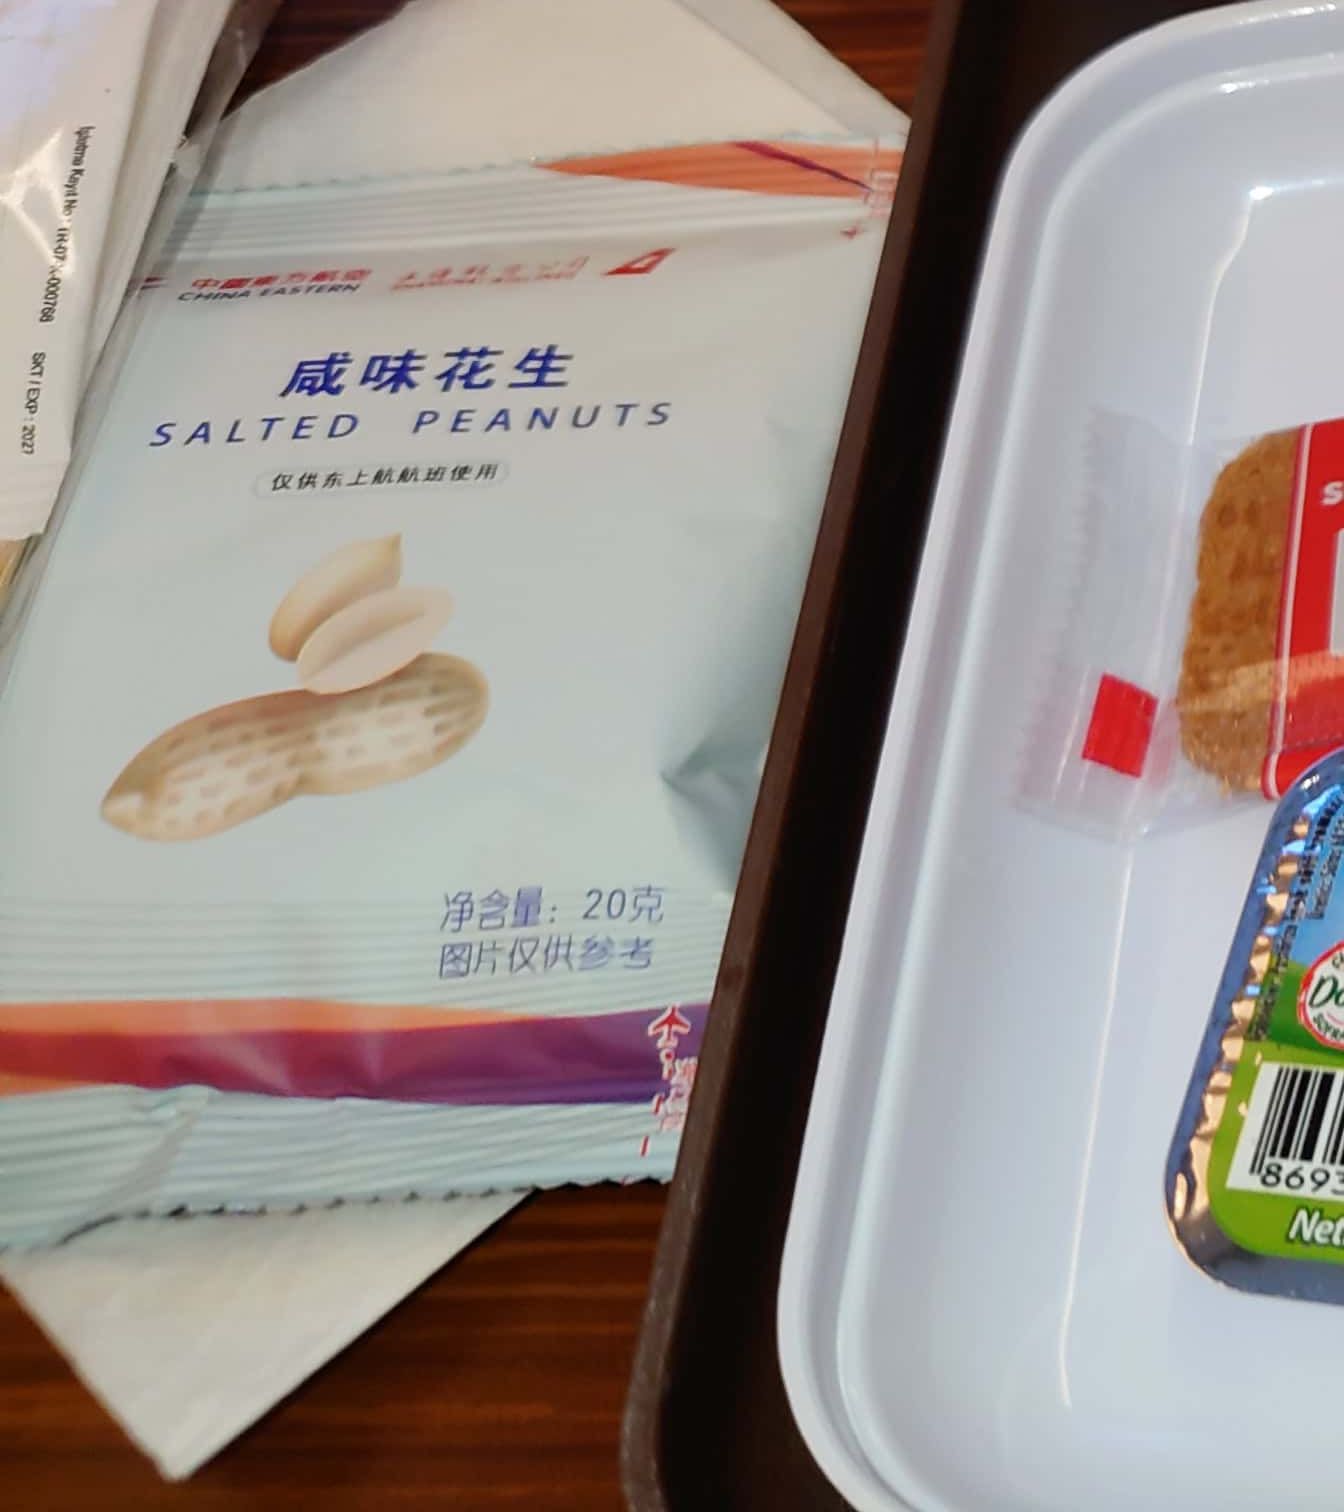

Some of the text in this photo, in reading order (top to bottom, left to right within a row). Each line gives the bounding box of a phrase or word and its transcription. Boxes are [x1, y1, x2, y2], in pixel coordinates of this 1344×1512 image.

[177, 283, 361, 302] CHINA EASTERN
[30, 351, 46, 377] SKT
[279, 343, 575, 399] 咸味花生
[25, 387, 41, 415] EXP
[147, 400, 673, 448] SALTED PEANUTS
[270, 461, 501, 492] 仅供东上航航班使用
[439, 933, 654, 980] 图片仅供参考
